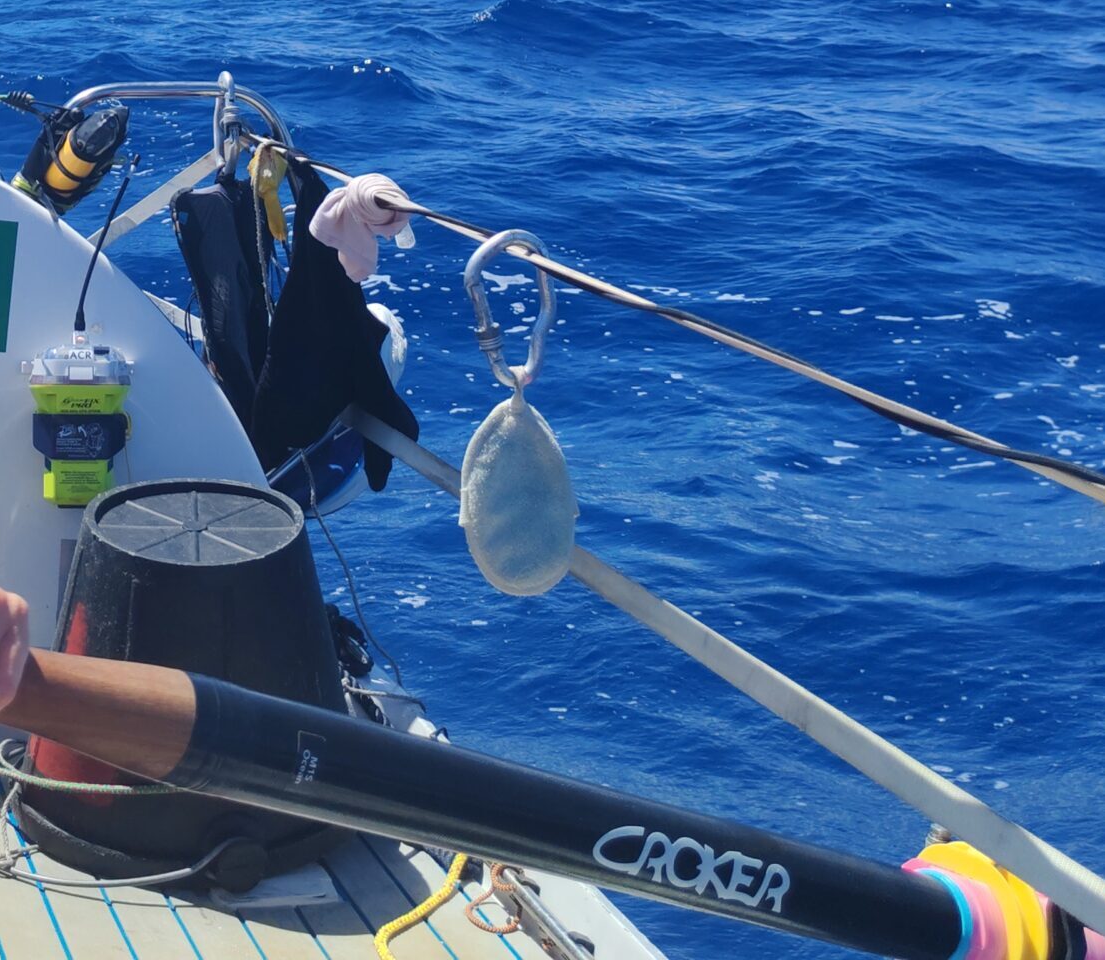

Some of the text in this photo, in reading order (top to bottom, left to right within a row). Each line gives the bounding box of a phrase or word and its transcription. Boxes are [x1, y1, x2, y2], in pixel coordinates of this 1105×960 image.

[70, 351, 92, 360] ACR
[305, 756, 319, 782] M1S
[593, 826, 791, 913] CROKER
